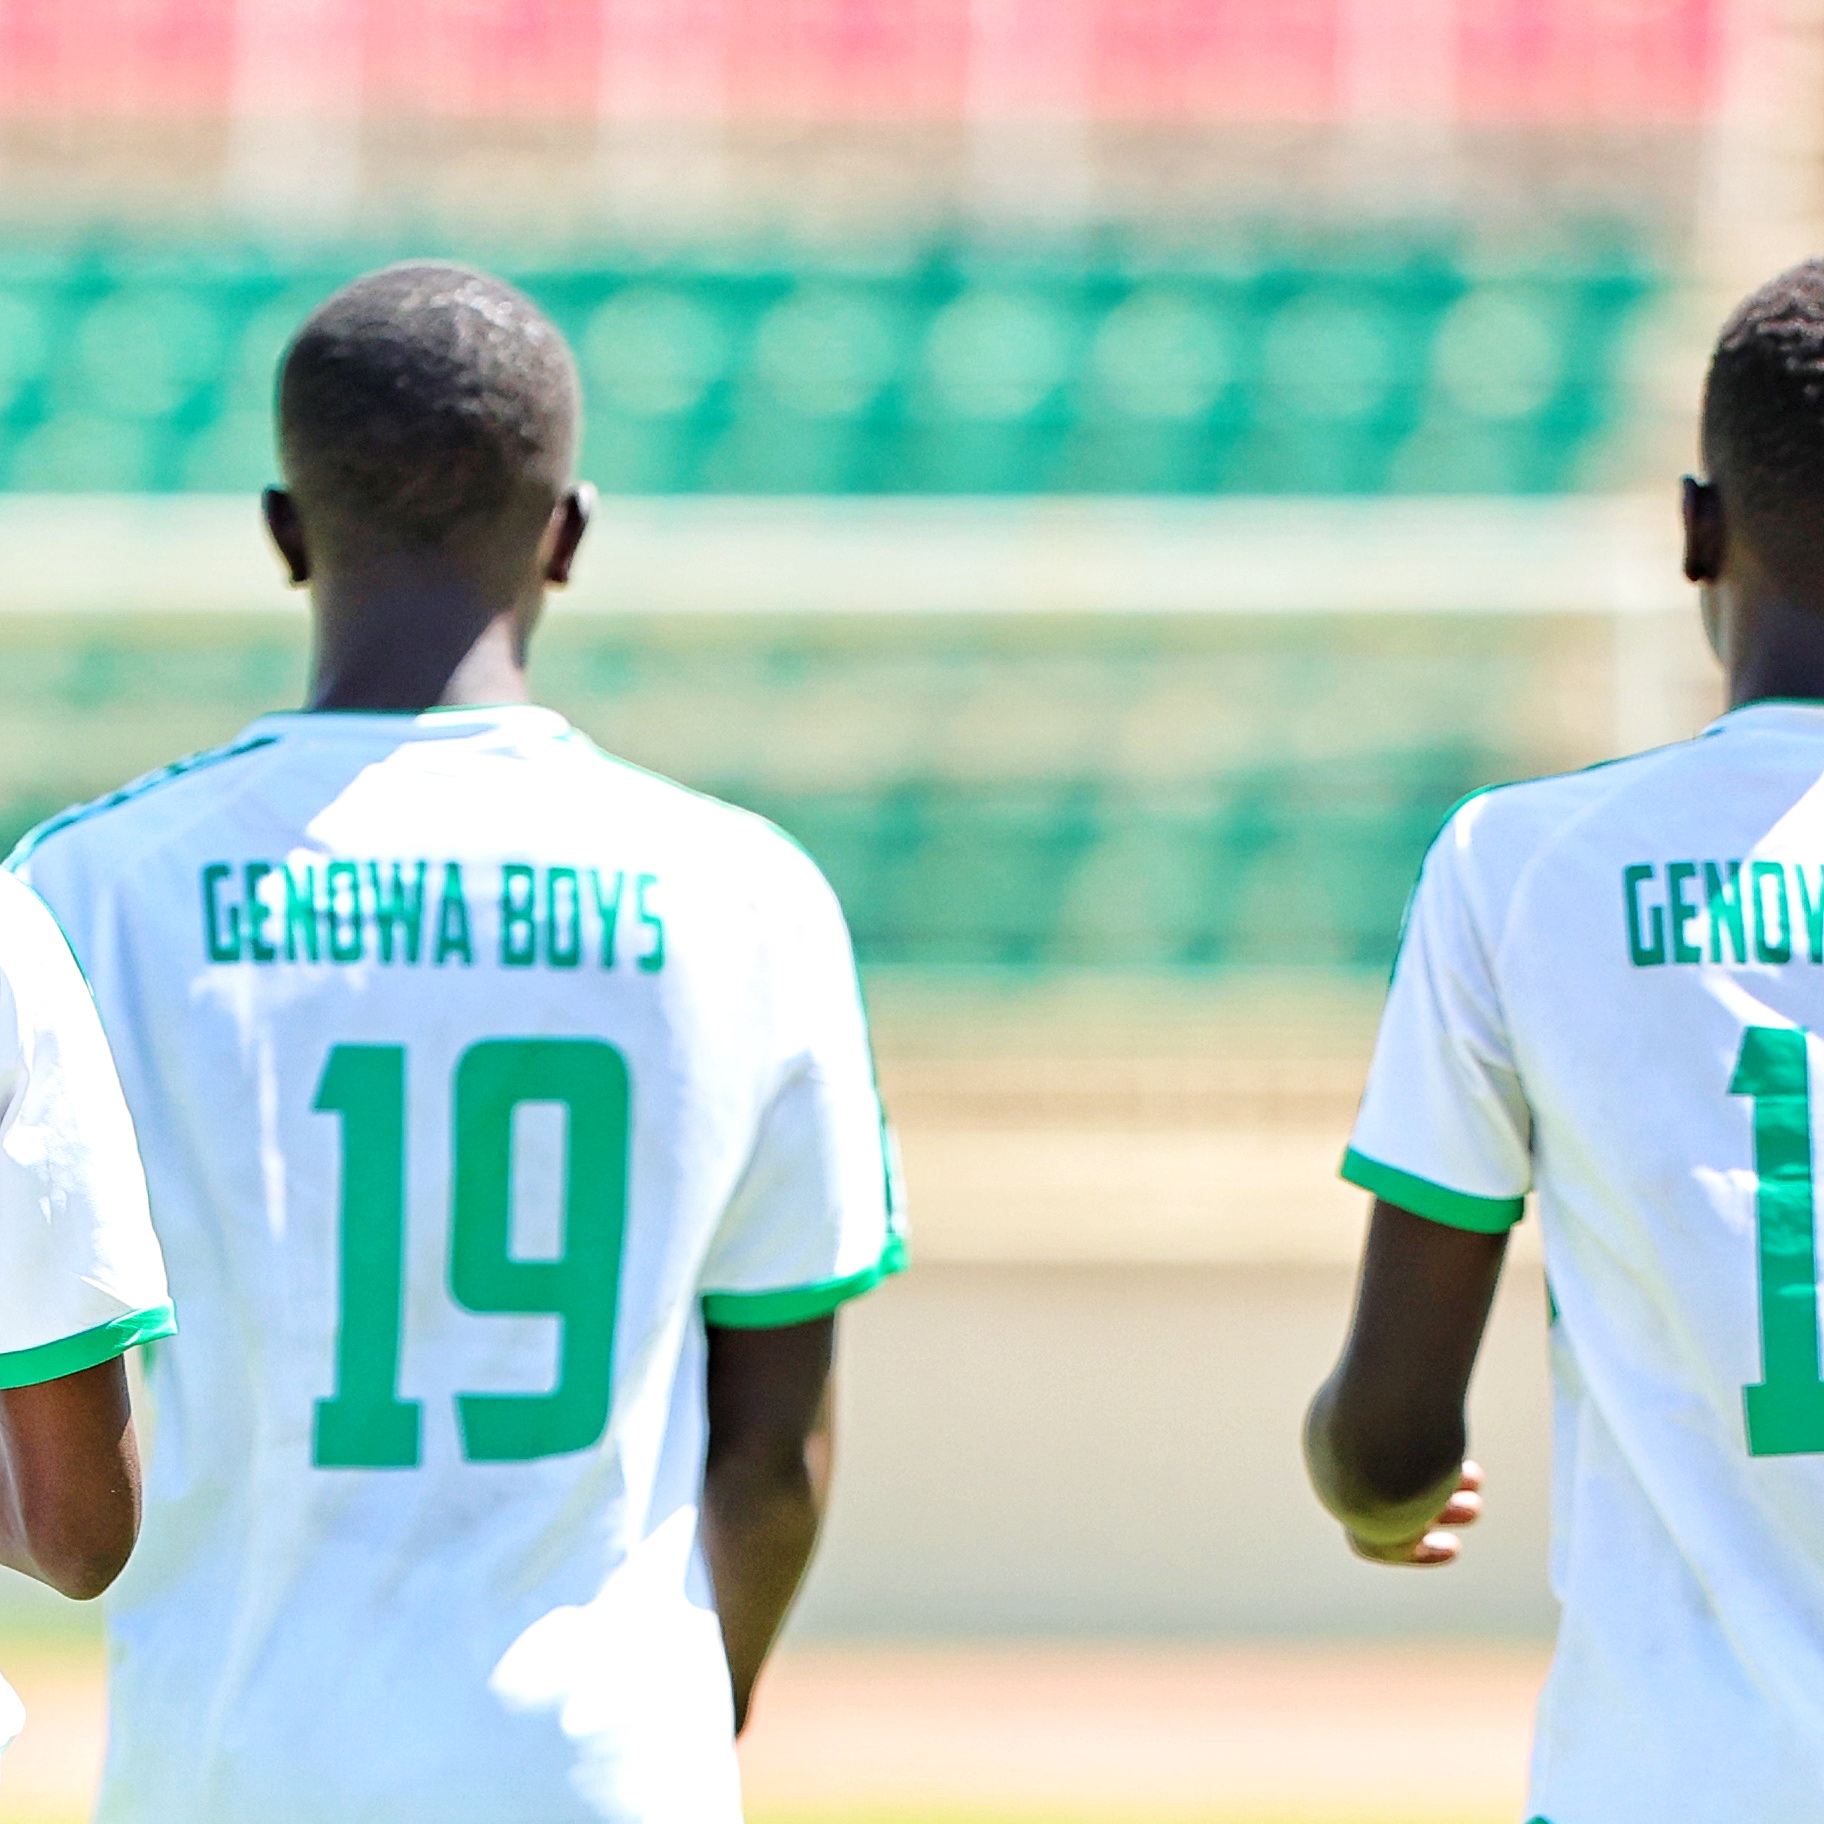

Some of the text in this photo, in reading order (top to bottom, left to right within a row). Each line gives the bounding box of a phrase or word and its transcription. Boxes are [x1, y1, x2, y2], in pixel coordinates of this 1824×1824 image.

[201, 858, 666, 974] GENOWA BOYS
[312, 1036, 632, 1469] 19
